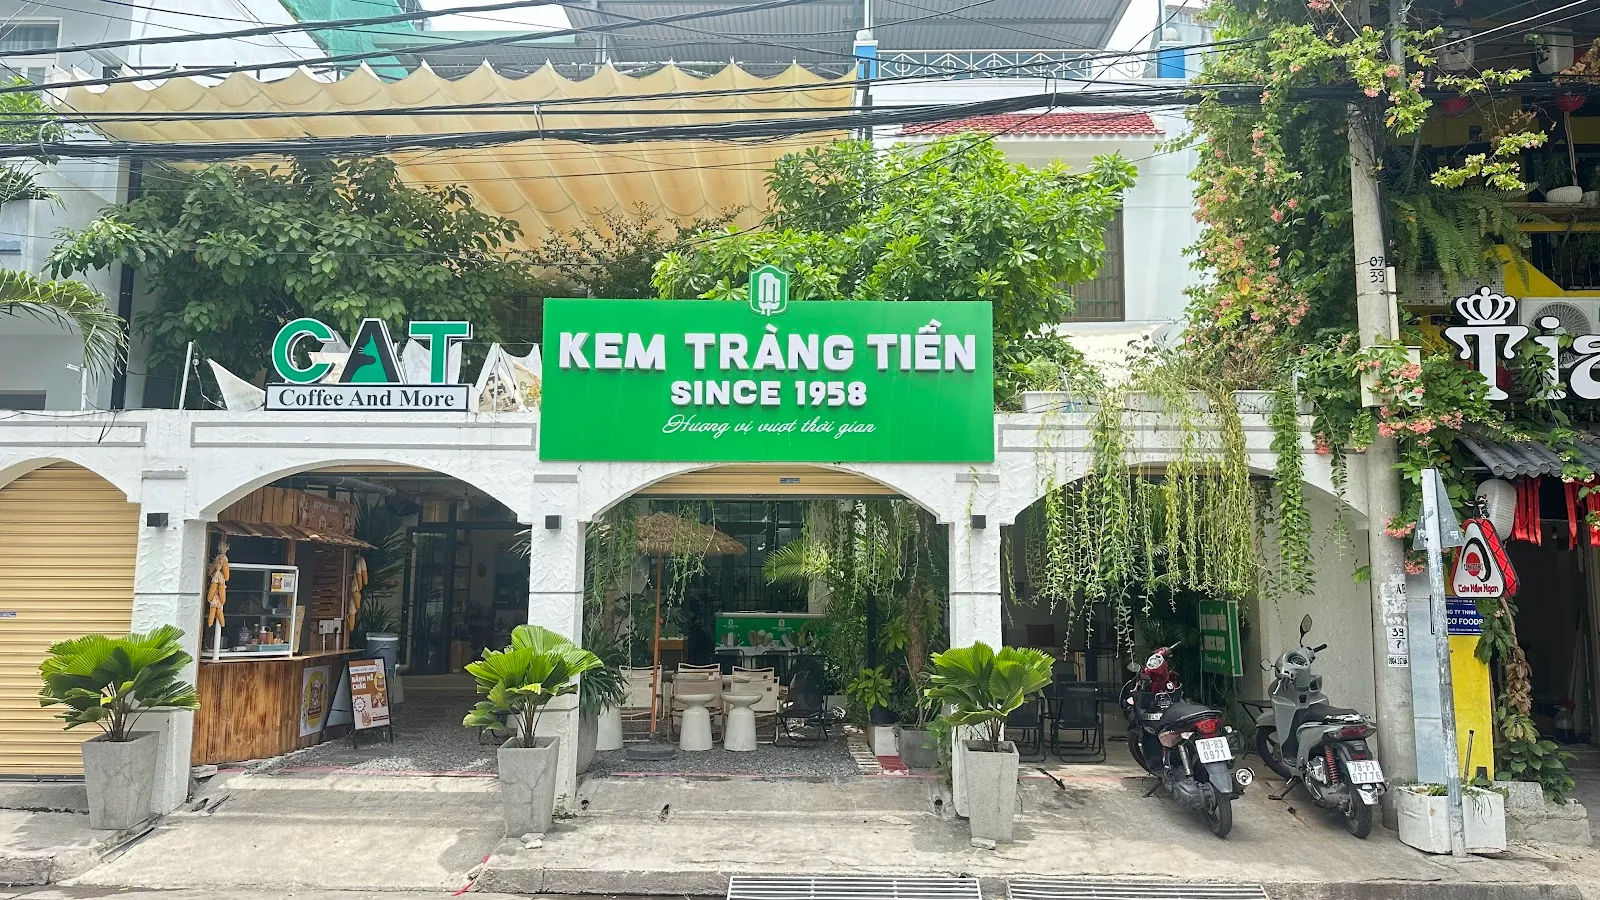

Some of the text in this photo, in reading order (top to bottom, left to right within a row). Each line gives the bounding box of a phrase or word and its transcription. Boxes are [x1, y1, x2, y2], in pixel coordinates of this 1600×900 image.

[1369, 257, 1384, 267] 07
[1370, 271, 1385, 283] 39
[271, 317, 474, 385] CAT
[559, 318, 976, 371] KEM TRÀNG TIỀN
[279, 388, 454, 408] Coffee And More
[671, 379, 867, 407] SINCE 1958
[833, 421, 877, 440] gian
[1459, 618, 1484, 626] FOODS
[1203, 750, 1226, 760] 0971
